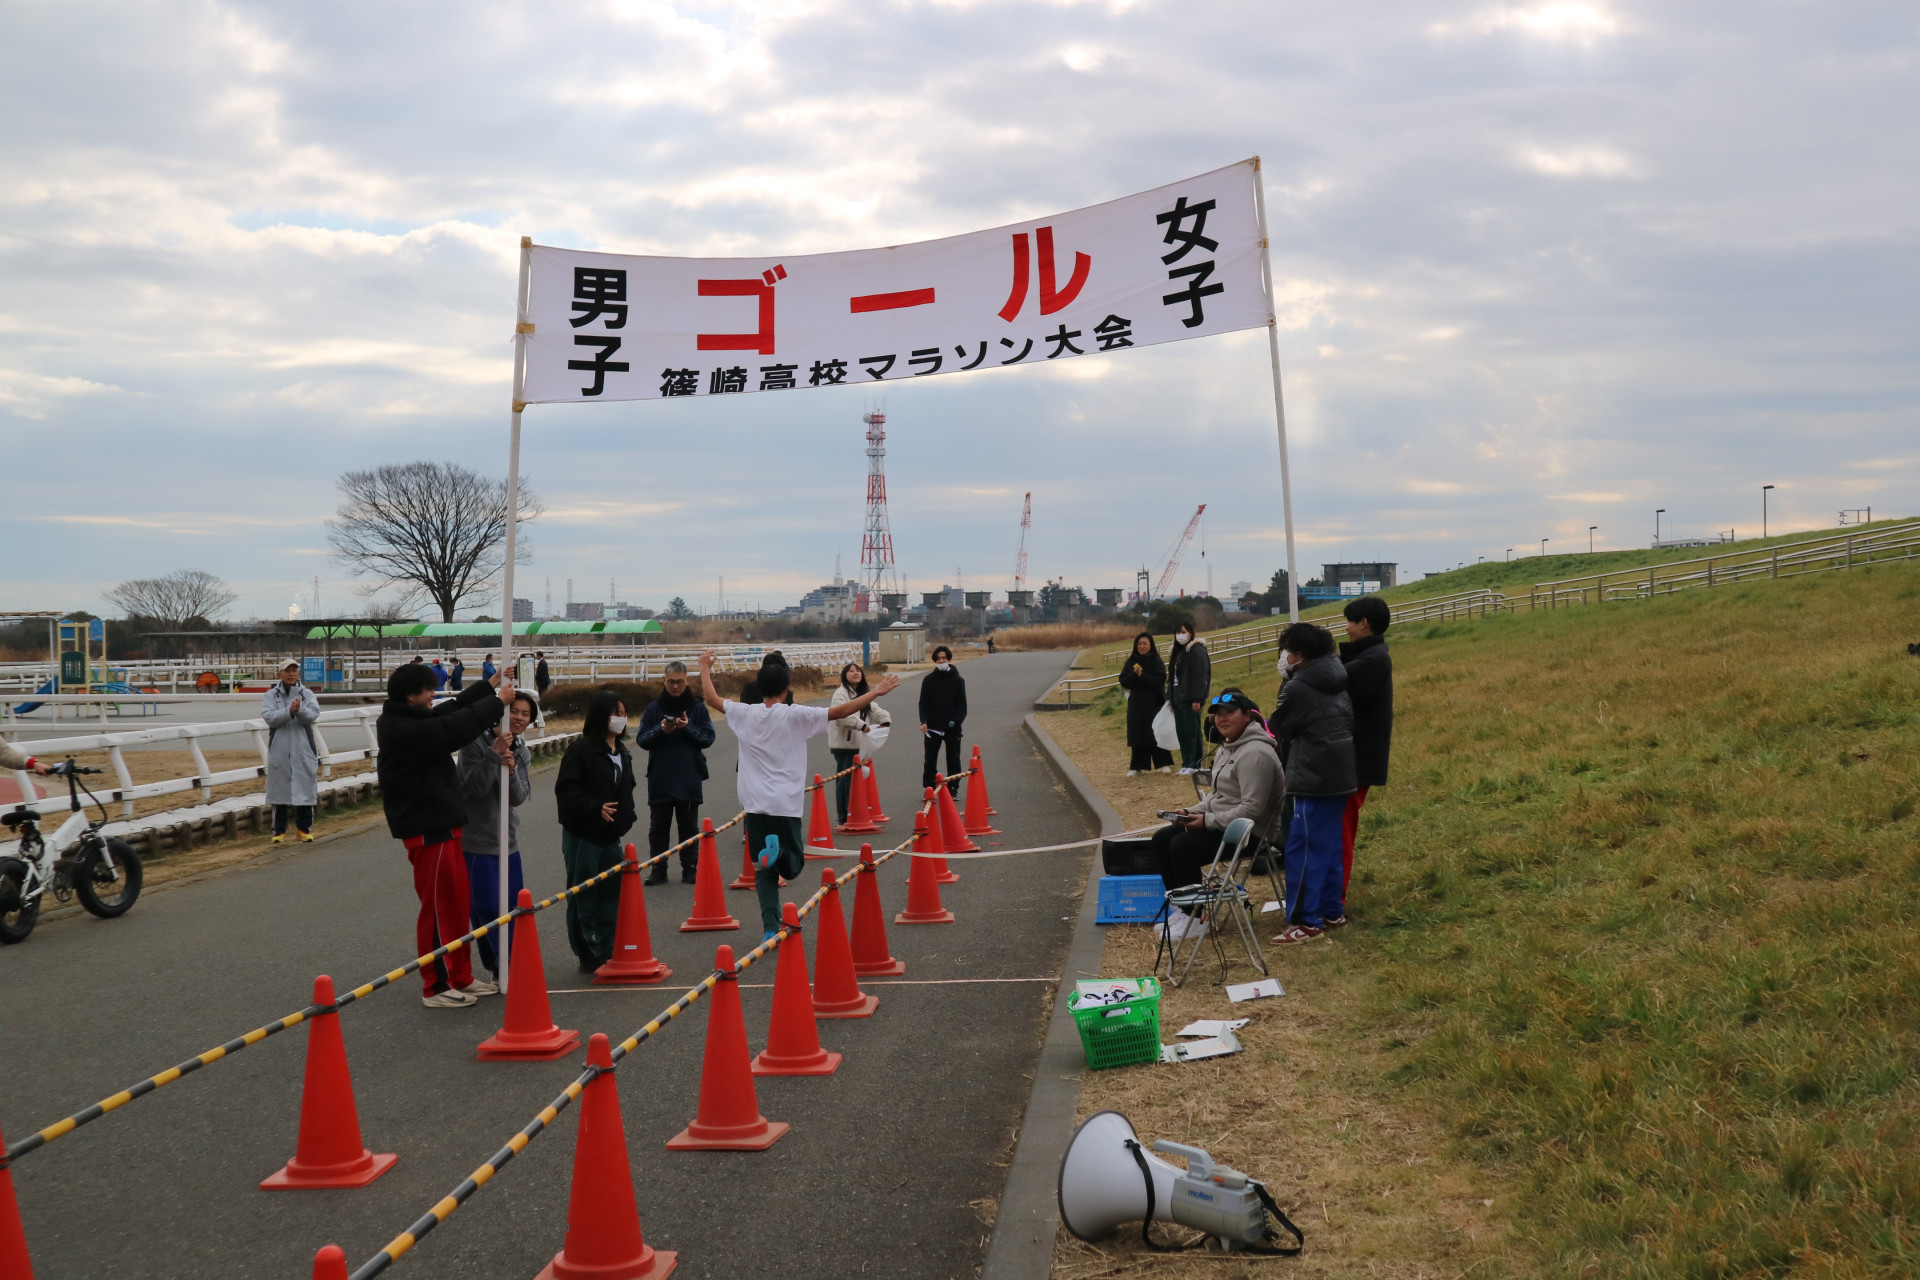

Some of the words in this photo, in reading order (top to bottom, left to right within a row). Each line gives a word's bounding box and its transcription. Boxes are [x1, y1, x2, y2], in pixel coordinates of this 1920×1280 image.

[697, 226, 1091, 355] ゴール
[1156, 196, 1225, 329] 女子
[568, 267, 630, 397] 男子
[659, 313, 1135, 397] 篠崎高校マラソン大会
[1187, 1189, 1213, 1202] molten
